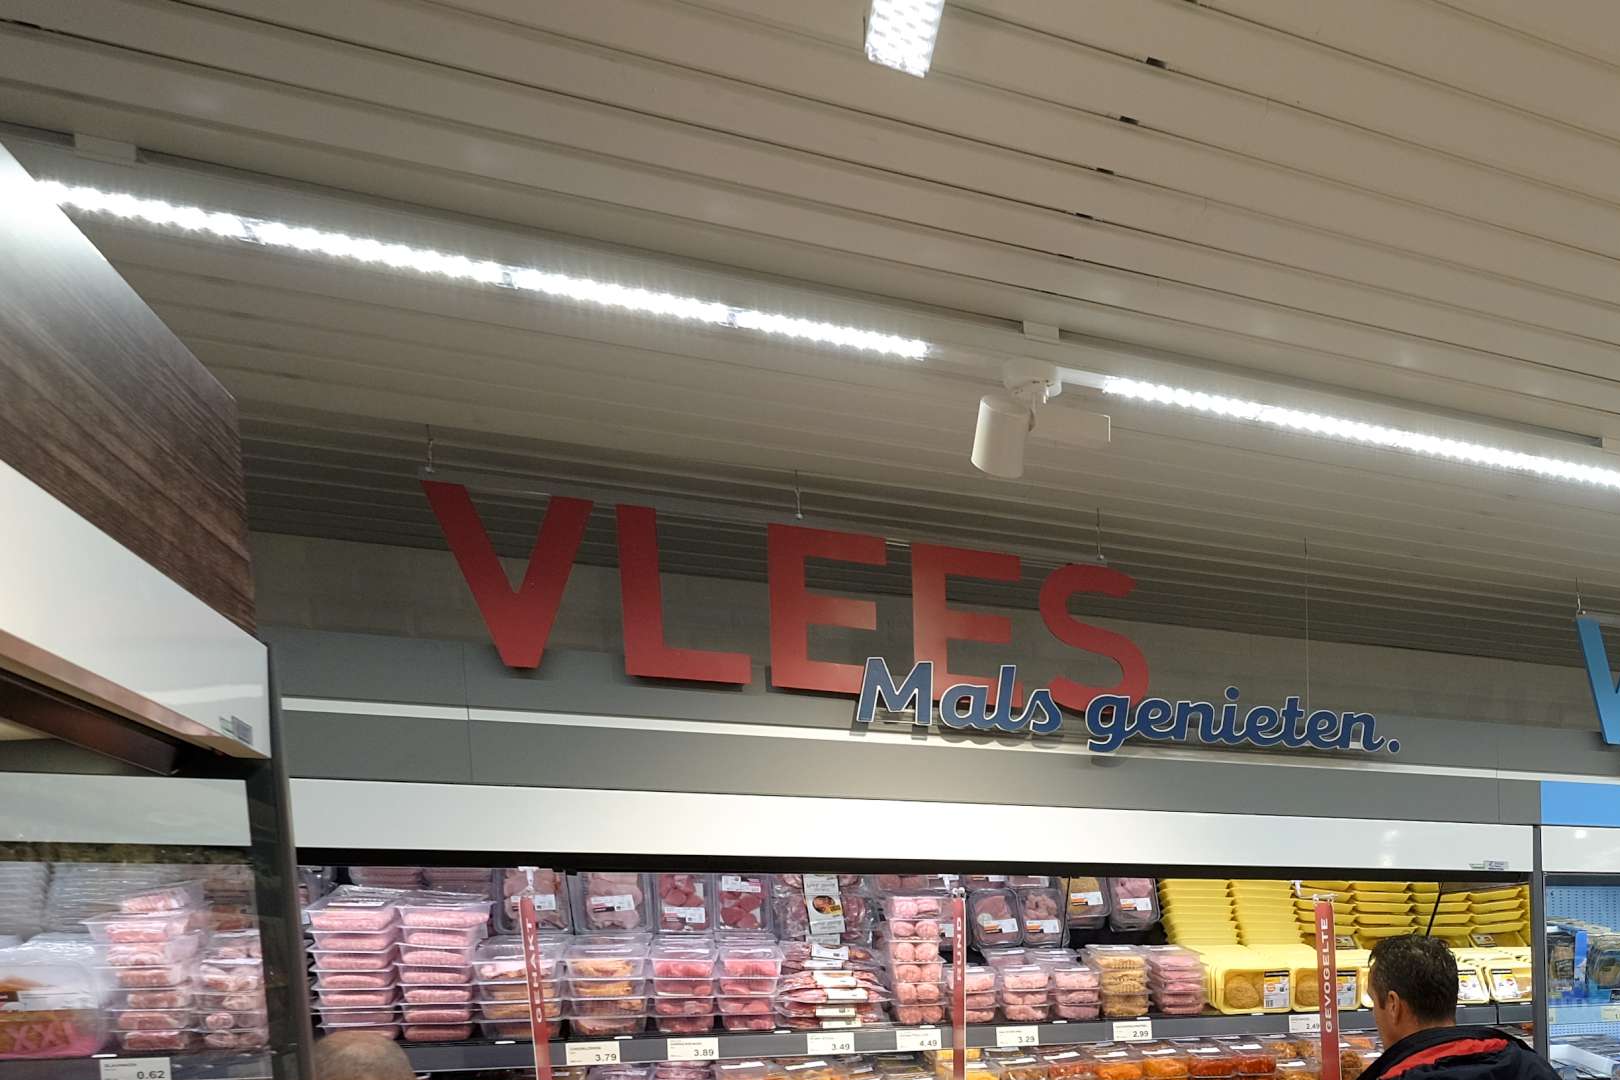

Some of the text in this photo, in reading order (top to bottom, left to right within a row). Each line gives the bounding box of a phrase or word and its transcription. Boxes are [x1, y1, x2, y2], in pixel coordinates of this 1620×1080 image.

[421, 480, 1149, 711] VLEES
[856, 657, 1400, 753] Mals genieten.
[1320, 917, 1334, 1034] GEVOGELTE
